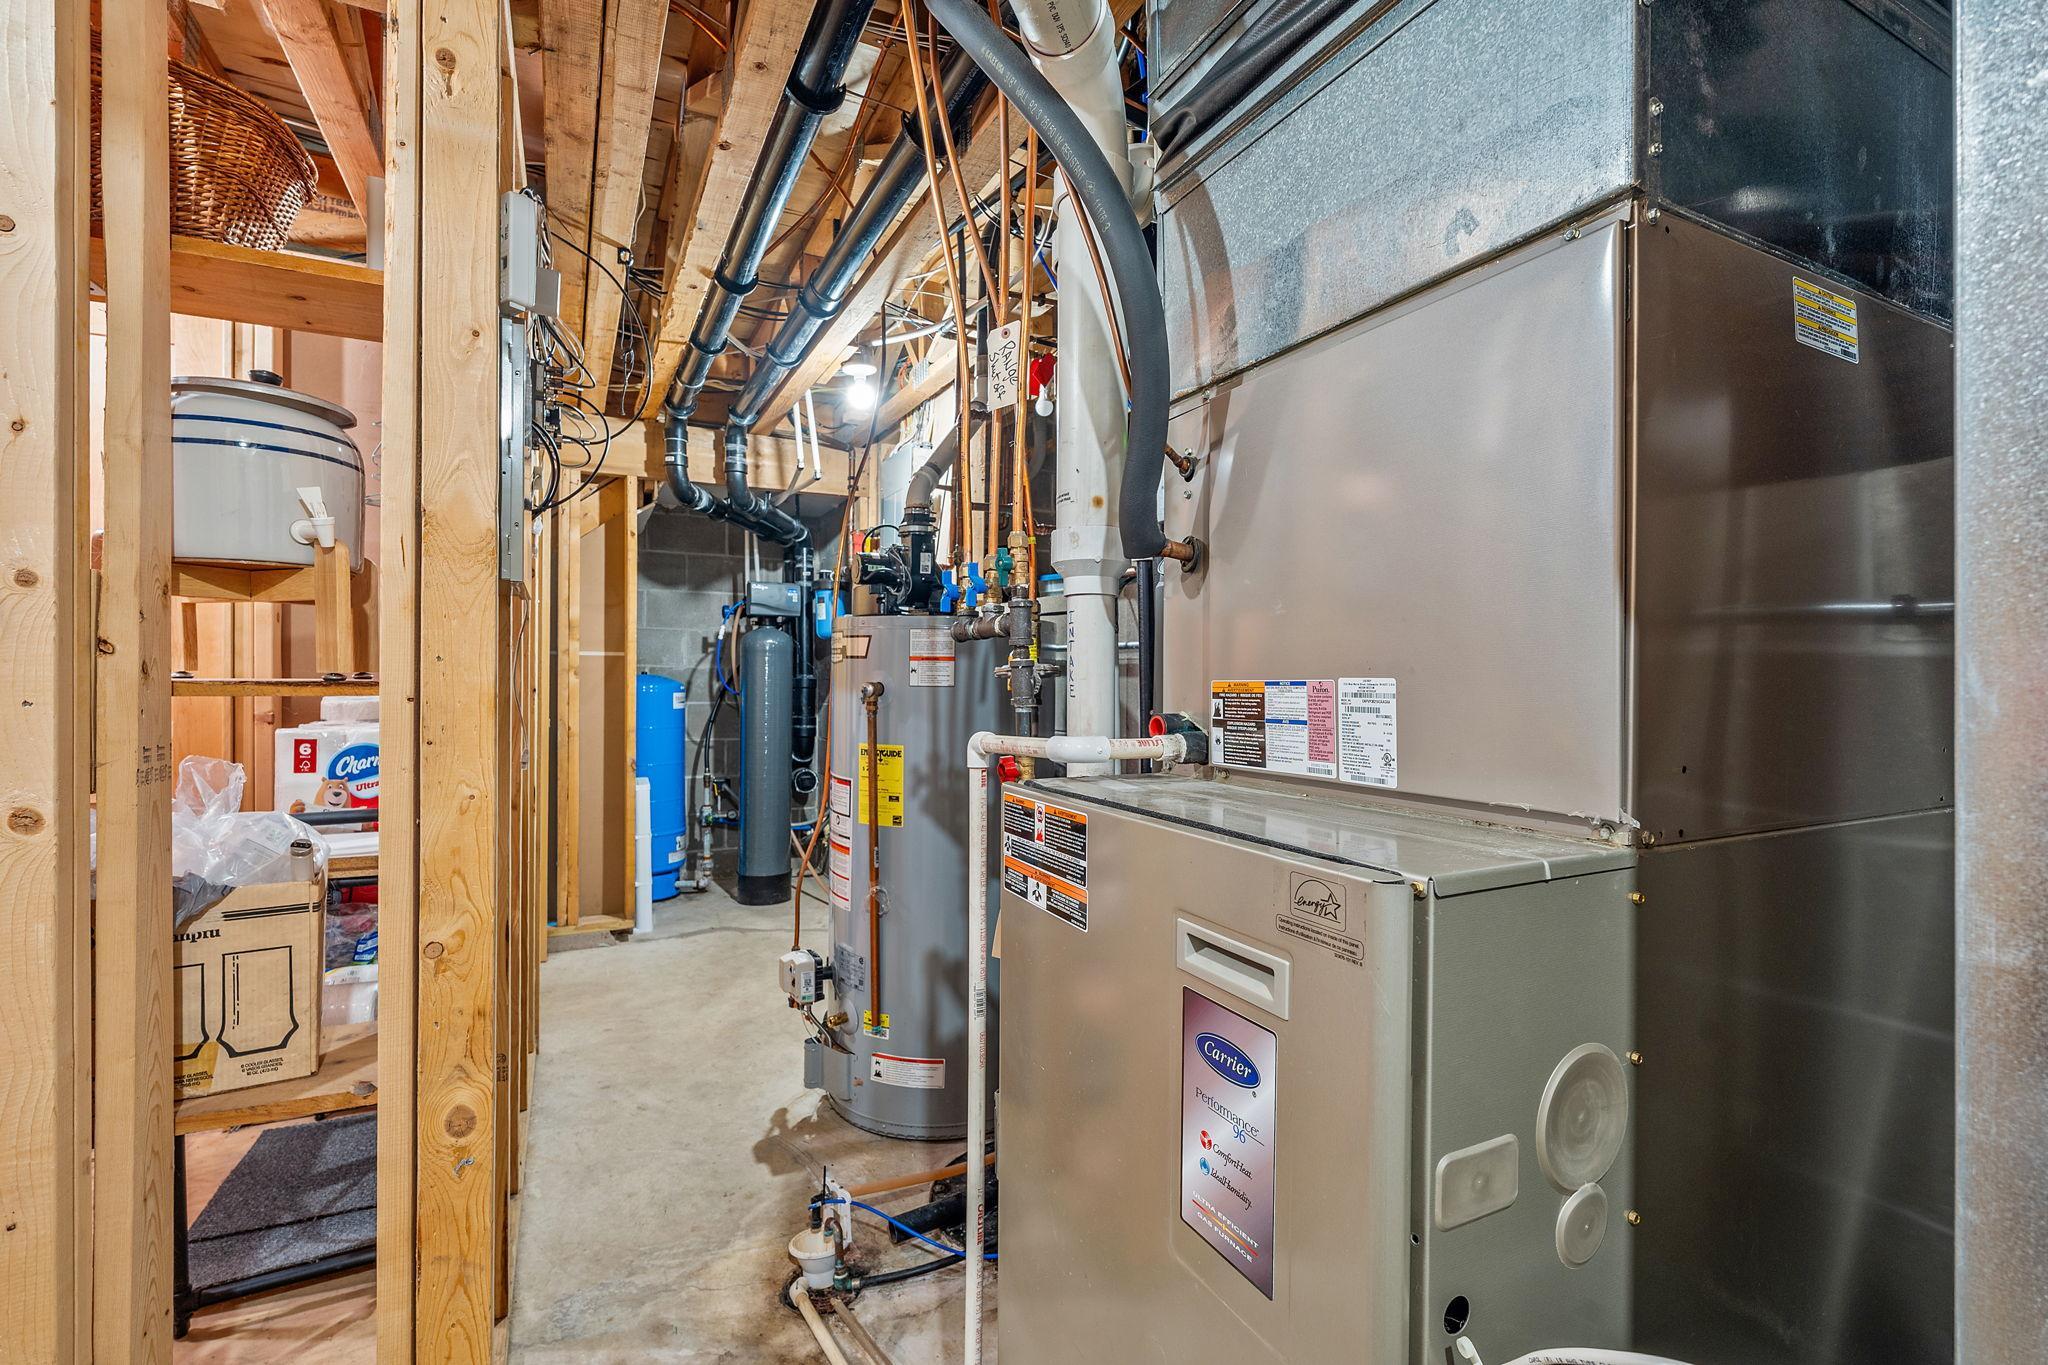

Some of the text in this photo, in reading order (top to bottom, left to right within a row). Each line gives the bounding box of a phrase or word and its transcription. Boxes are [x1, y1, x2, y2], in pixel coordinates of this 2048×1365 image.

[1062, 143, 1086, 180] RESISTANT
[299, 744, 312, 755] 6
[1204, 1041, 1252, 1078] Carrier
[1195, 1086, 1258, 1136] Performance
[1232, 1124, 1246, 1144] 96
[1193, 1190, 1259, 1248] ULTRA EFFICIENT
[1197, 1212, 1252, 1263] GAS FURNACE
